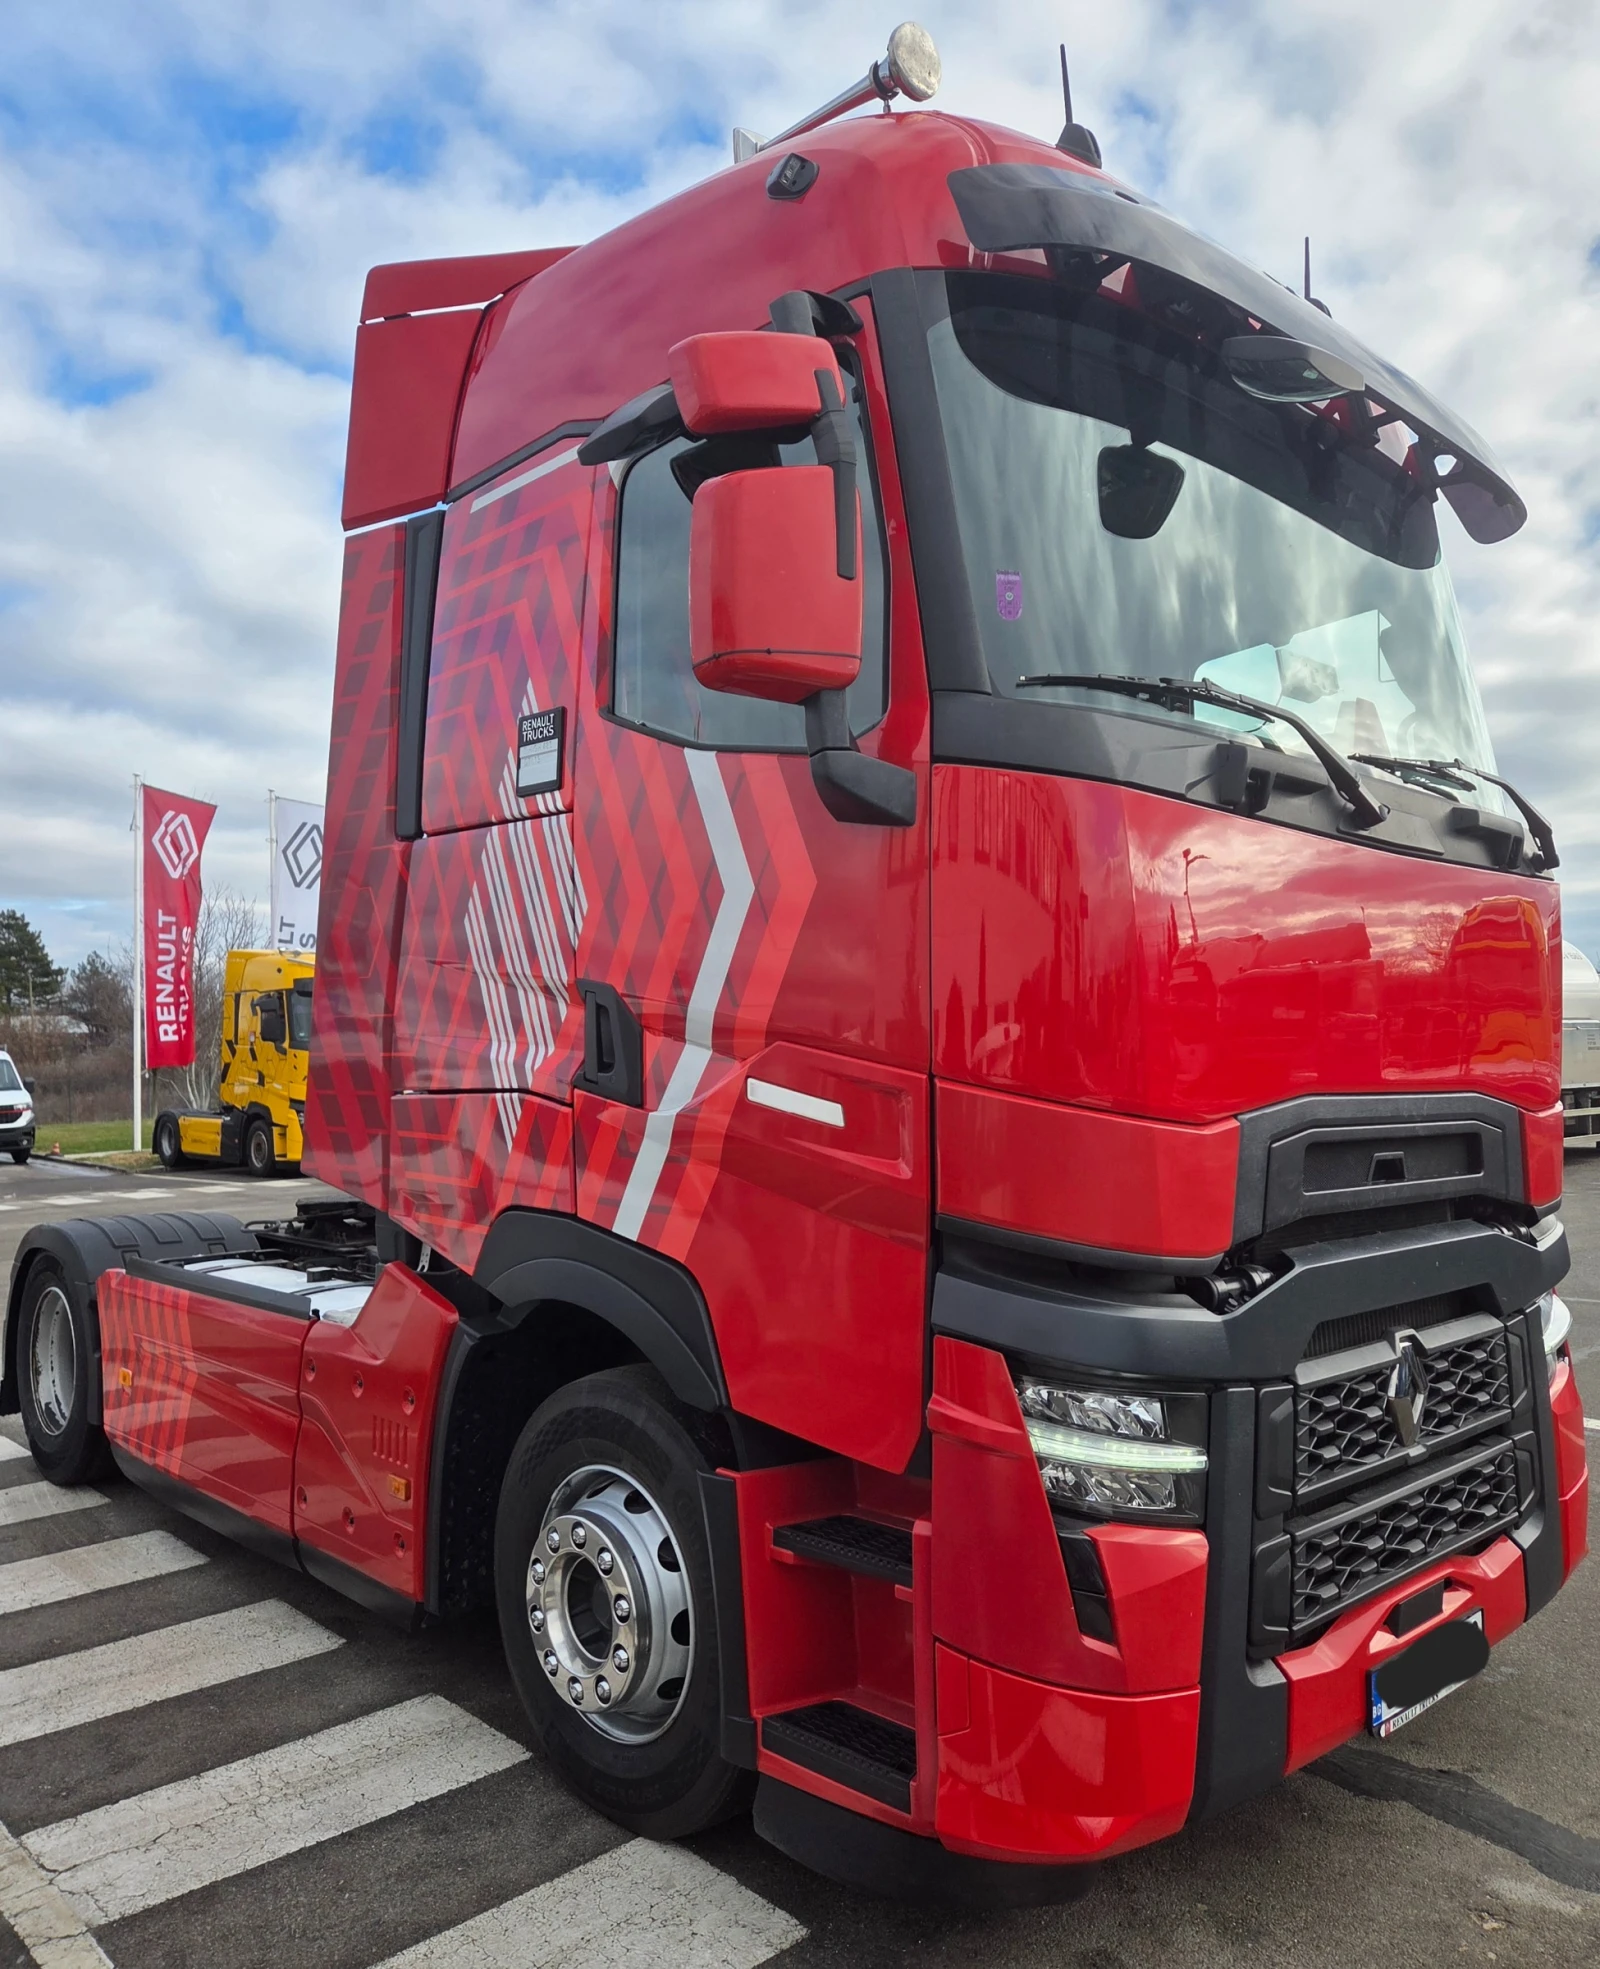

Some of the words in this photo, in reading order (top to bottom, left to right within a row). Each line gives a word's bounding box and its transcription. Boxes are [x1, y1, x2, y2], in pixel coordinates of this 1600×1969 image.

[522, 713, 555, 732] RENAULT
[522, 725, 555, 742] TRUCKS
[156, 909, 179, 1042] RENAULT
[1372, 1703, 1382, 1719] BG
[1392, 1706, 1418, 1730] RENAULT
